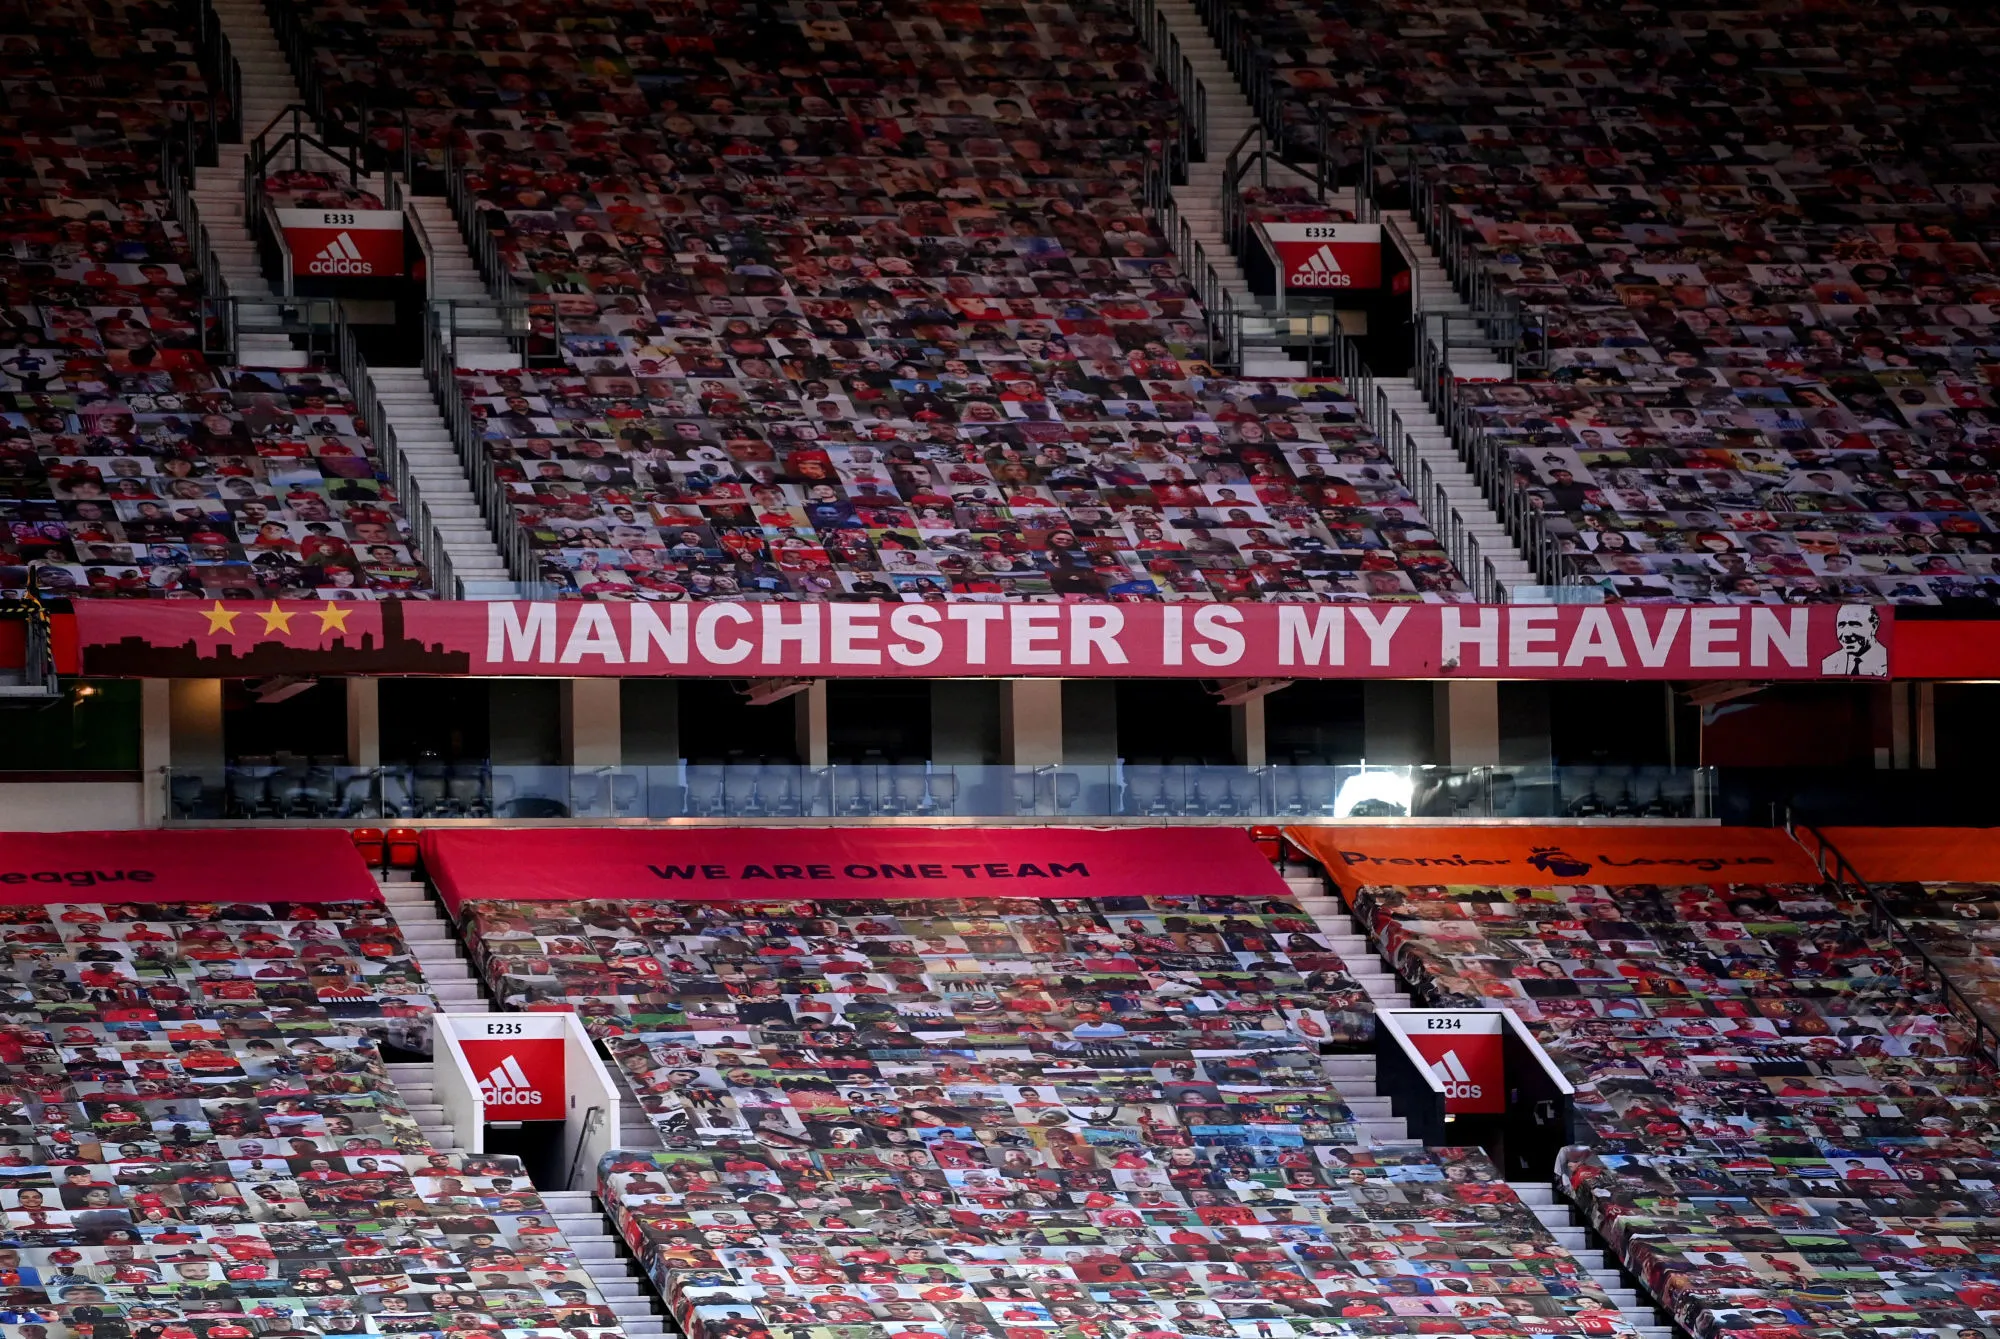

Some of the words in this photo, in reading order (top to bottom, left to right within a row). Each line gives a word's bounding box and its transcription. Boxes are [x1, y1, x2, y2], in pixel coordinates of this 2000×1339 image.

[324, 214, 354, 224] E333
[1305, 228, 1336, 237] E332
[309, 258, 372, 274] adidas
[1292, 270, 1351, 286] adidas
[486, 601, 1129, 665] MANCHESTER
[1163, 604, 1246, 666] IS
[1278, 605, 1410, 665] MY
[1441, 606, 1808, 667] HEAVEN
[1339, 851, 1511, 866] Premier
[1598, 855, 1774, 871] League
[0, 869, 156, 887] eague
[648, 864, 730, 880] WE
[741, 864, 835, 880] ARE
[844, 863, 947, 880] ONE
[952, 862, 1090, 879] TEAM
[487, 1023, 522, 1034] E235
[1427, 1018, 1461, 1029] E234
[483, 1087, 542, 1105] didas
[1445, 1081, 1482, 1098] das
